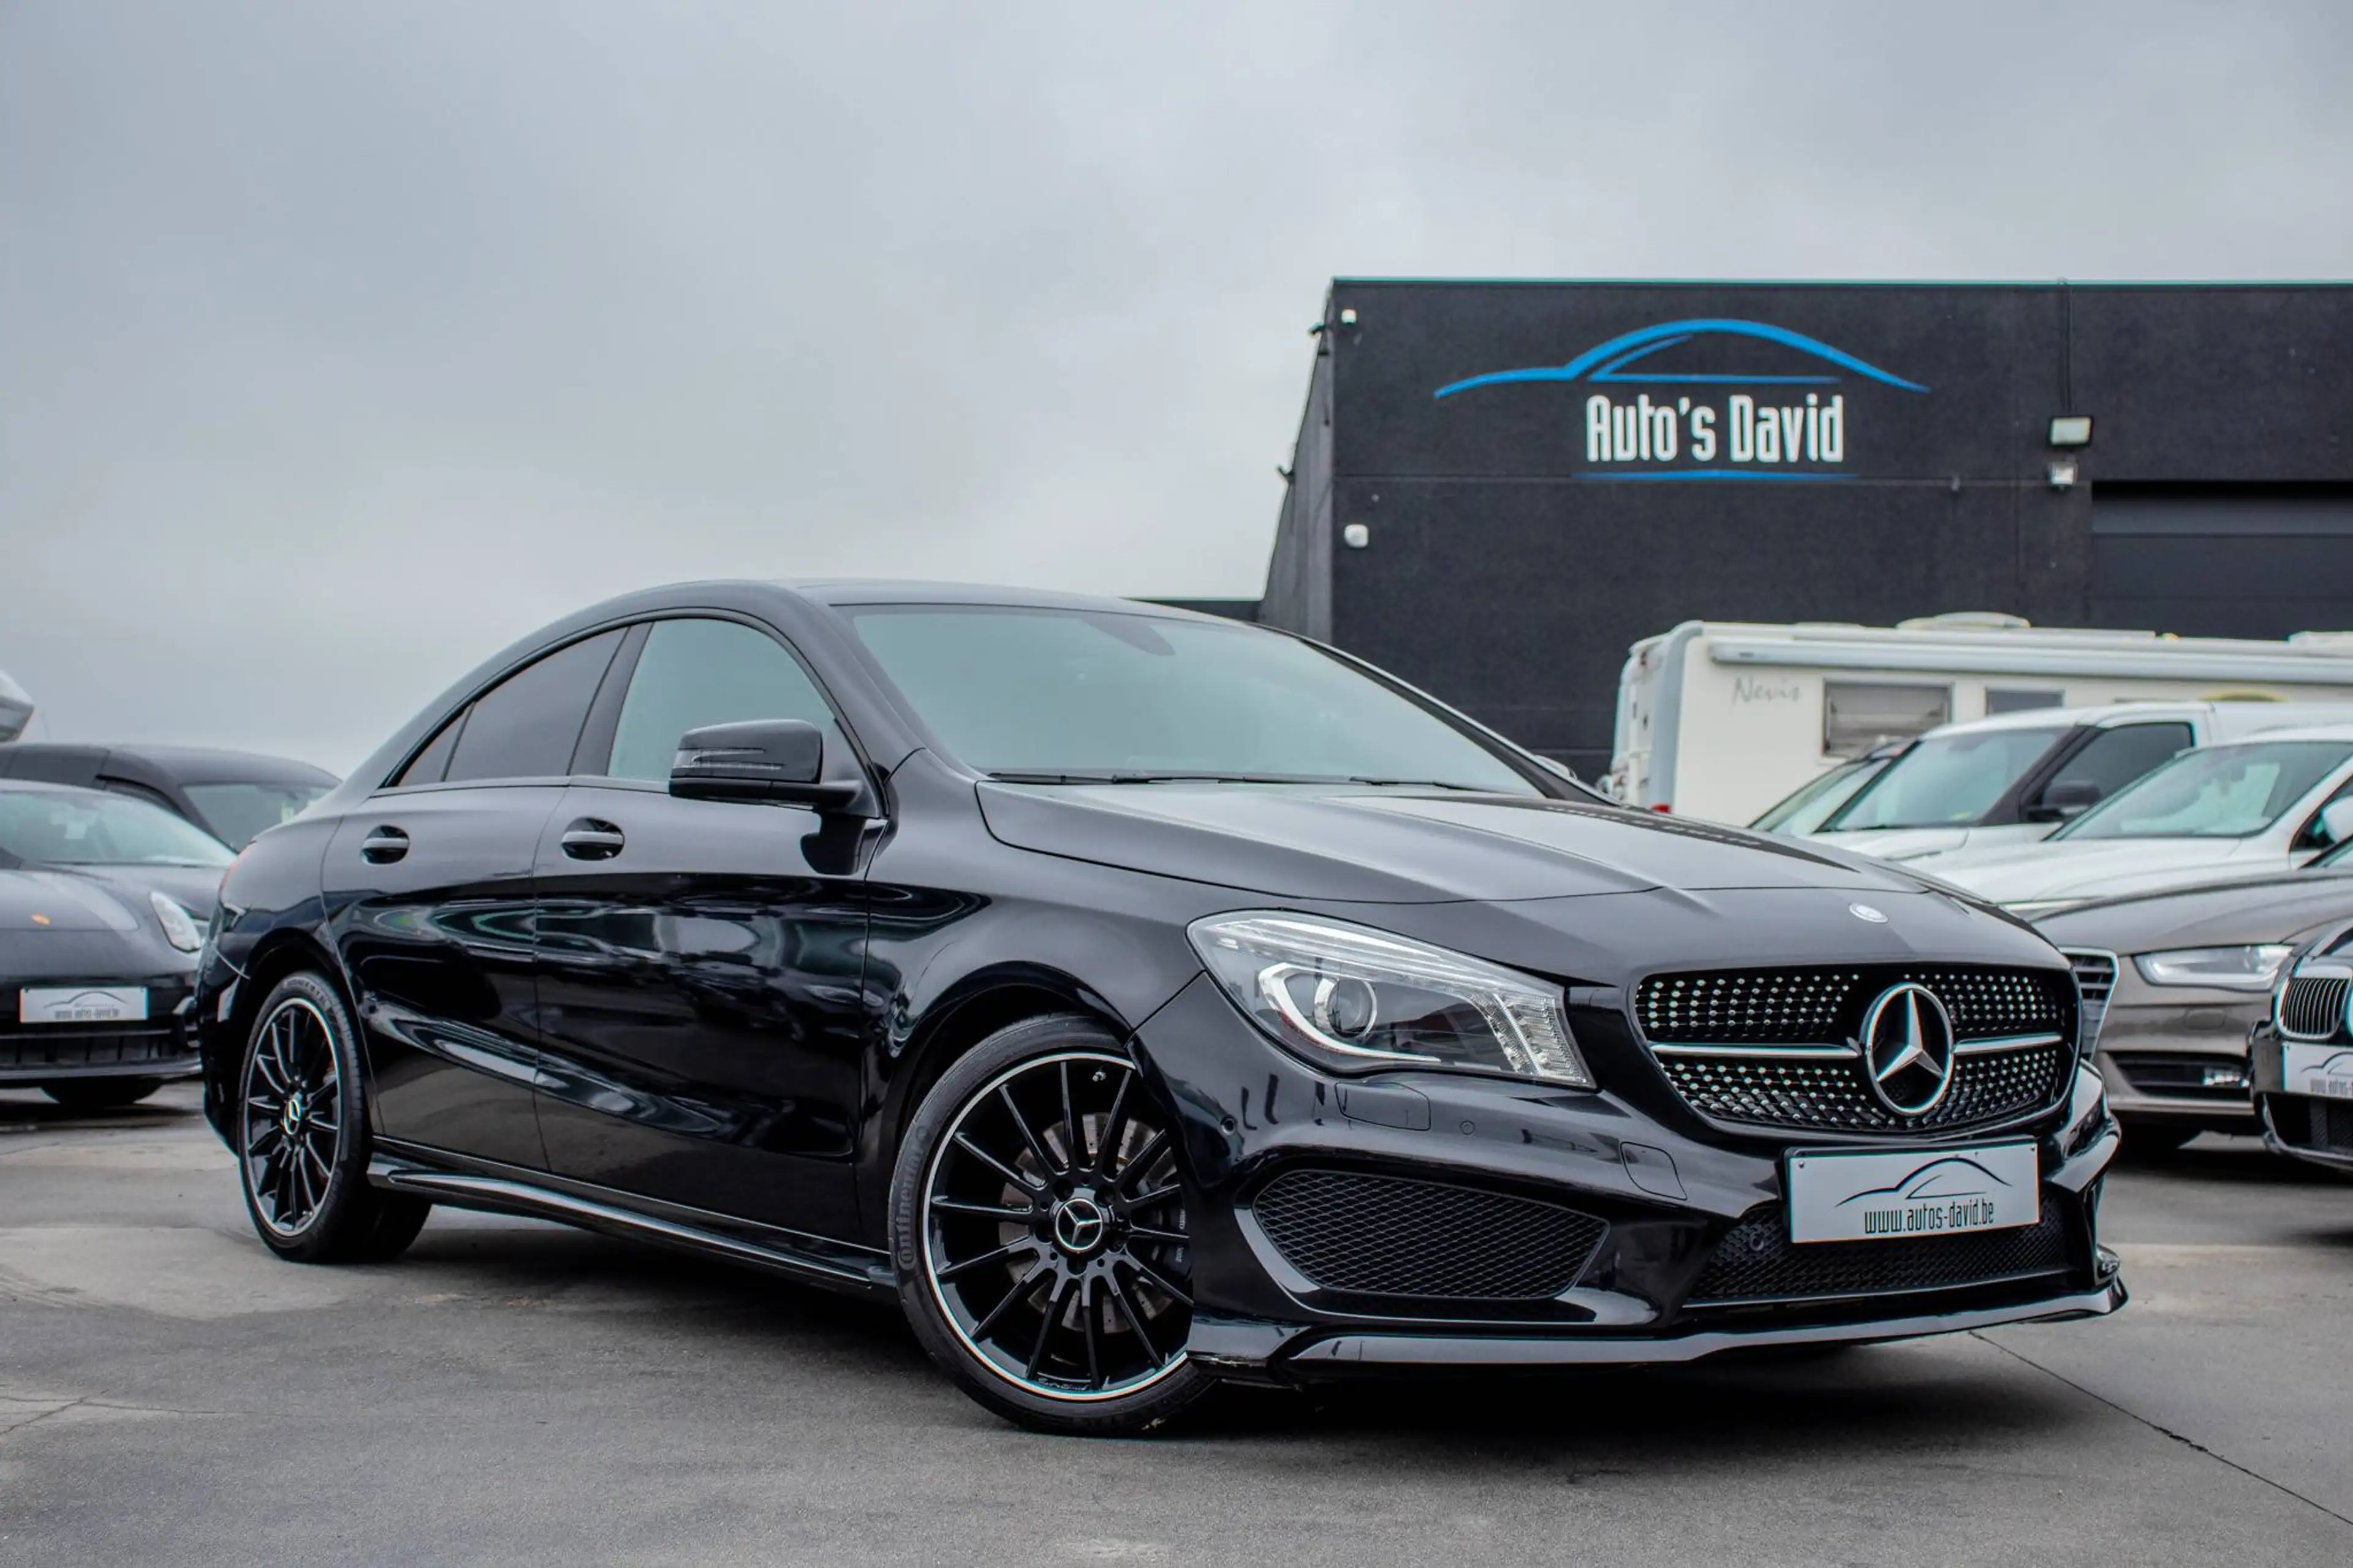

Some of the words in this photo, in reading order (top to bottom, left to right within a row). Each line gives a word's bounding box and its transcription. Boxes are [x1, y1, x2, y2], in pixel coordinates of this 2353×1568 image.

[1586, 393, 1716, 462] Auto's
[1729, 393, 1844, 463] David
[1865, 1199, 1993, 1233] www.autos-david.be
